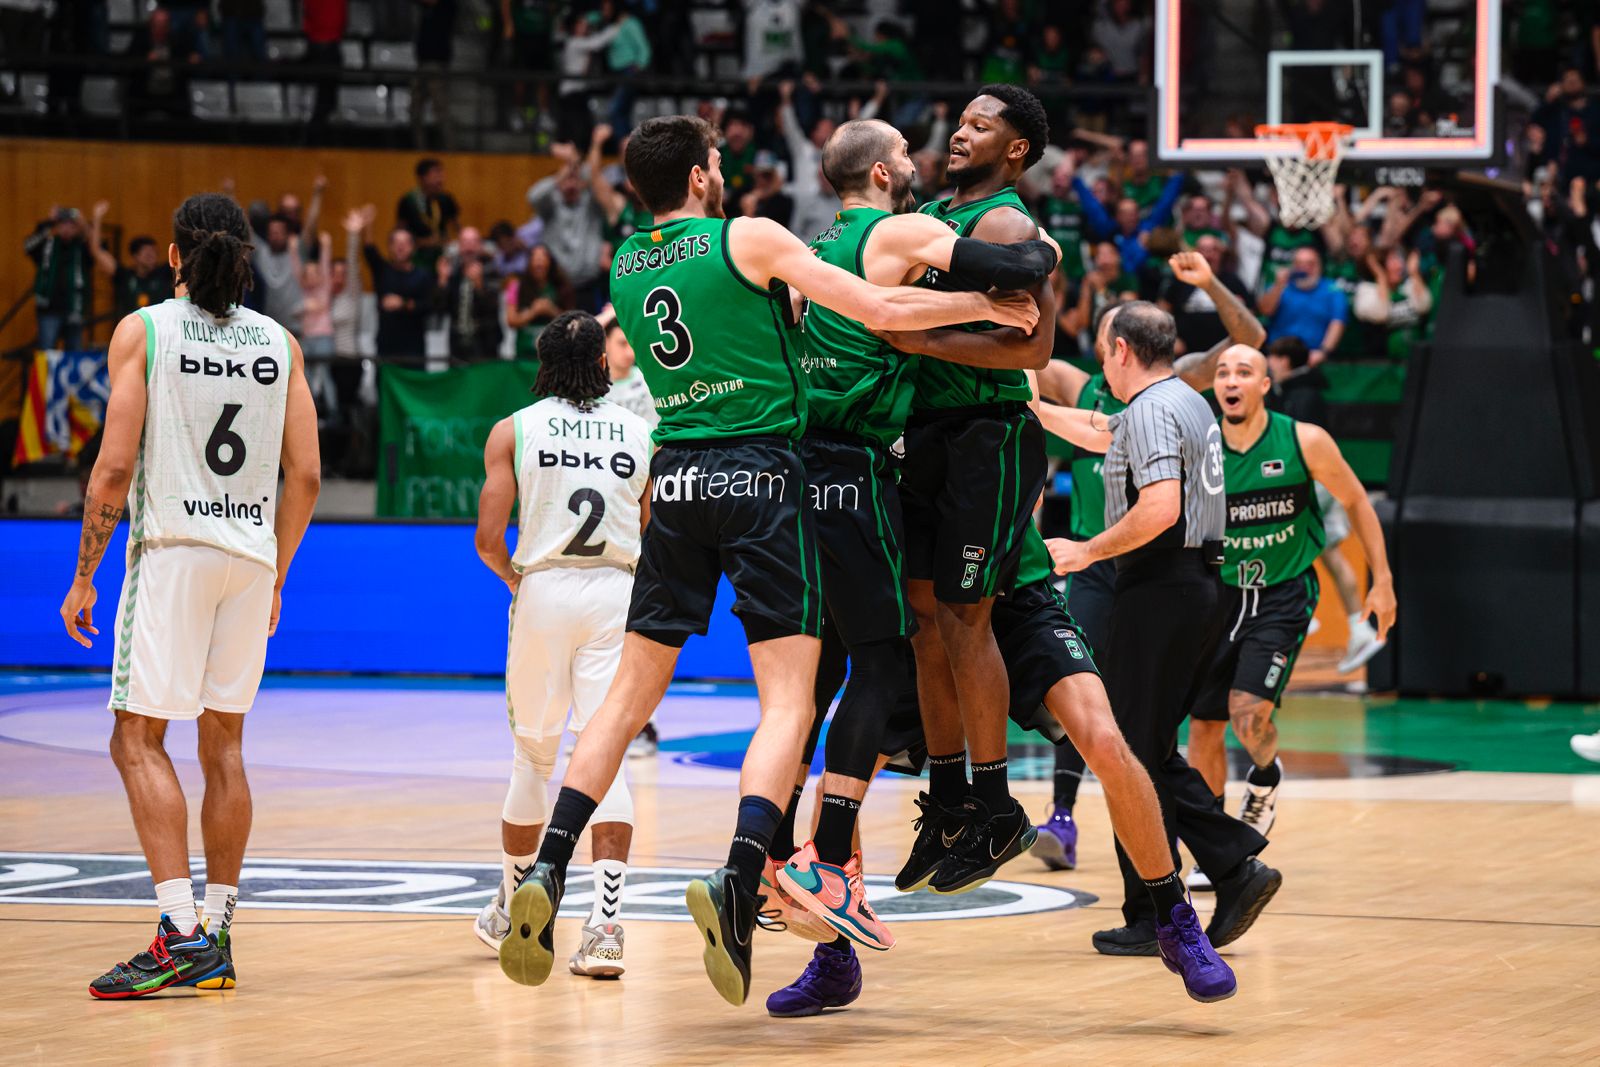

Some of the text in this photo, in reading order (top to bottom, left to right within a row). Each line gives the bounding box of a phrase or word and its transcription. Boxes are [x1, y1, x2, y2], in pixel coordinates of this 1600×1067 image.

[616, 233, 711, 279] BUSQUETS
[643, 285, 694, 370] 3
[180, 354, 247, 378] bbk
[711, 379, 744, 395] FUTUR
[205, 403, 246, 476] 6
[548, 417, 625, 442] SMITH
[538, 450, 604, 470] bbk
[183, 493, 263, 526] vueling
[561, 487, 606, 557] 2
[1229, 498, 1295, 522] PROBITAS
[965, 550, 980, 559] acb
[1237, 558, 1267, 589] 12
